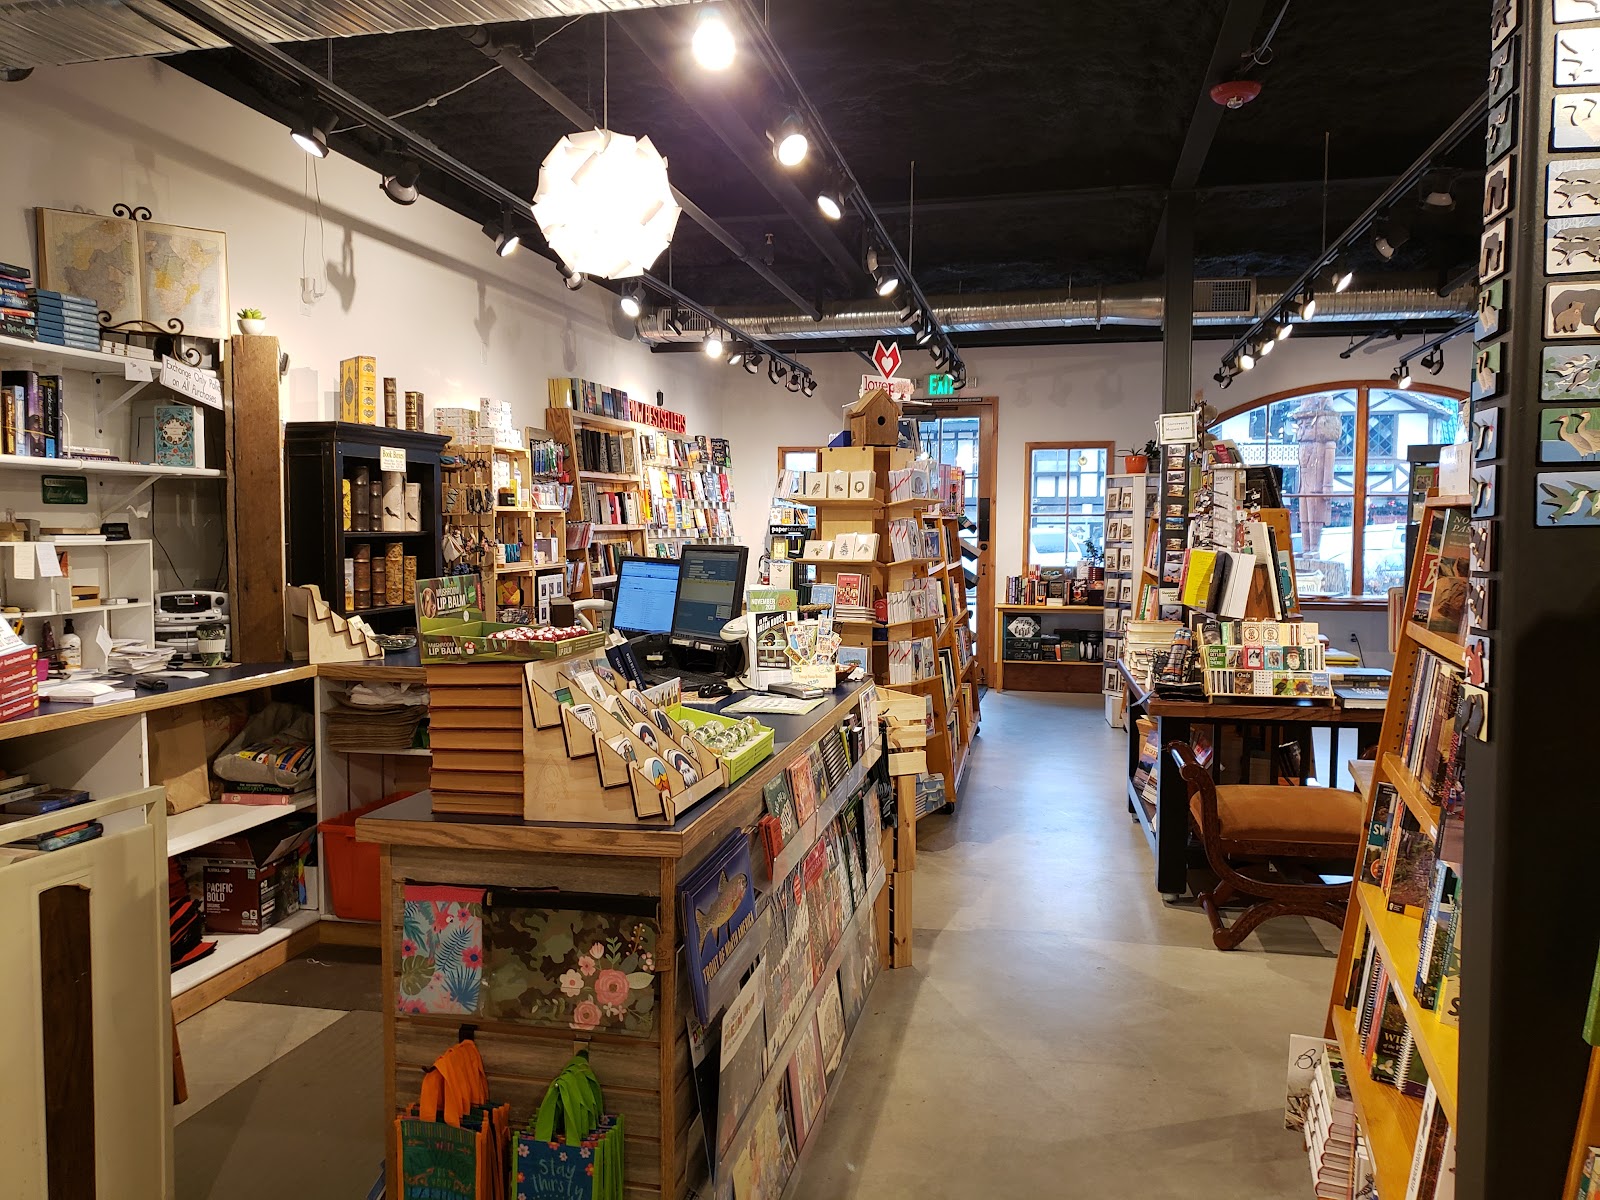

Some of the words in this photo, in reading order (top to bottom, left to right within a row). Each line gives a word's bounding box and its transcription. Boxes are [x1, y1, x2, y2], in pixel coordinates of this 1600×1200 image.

[166, 359, 192, 381] Exchange
[193, 372, 207, 392] Only
[172, 379, 180, 388] on
[181, 380, 190, 391] All
[191, 383, 217, 404] Purchases
[645, 405, 686, 434] BESTSELLERS
[1453, 515, 1471, 525] NO
[1451, 525, 1472, 534] PAS
[437, 596, 447, 611] LIP
[447, 594, 467, 609] BALM
[751, 598, 776, 606] NOVEMBER
[771, 613, 785, 629] HOUSE
[428, 648, 440, 656] LIP
[441, 646, 462, 655] BALM
[1373, 823, 1386, 837] SW
[206, 882, 233, 893] PACIFIC
[206, 892, 225, 902] BOLD
[702, 953, 720, 985] TROUT
[718, 946, 726, 967] OF
[724, 929, 740, 958] NORTH
[737, 910, 755, 941] AMERICA
[1384, 1031, 1403, 1045] WI
[538, 1157, 576, 1180] stay
[531, 1173, 584, 1200] thirsty
